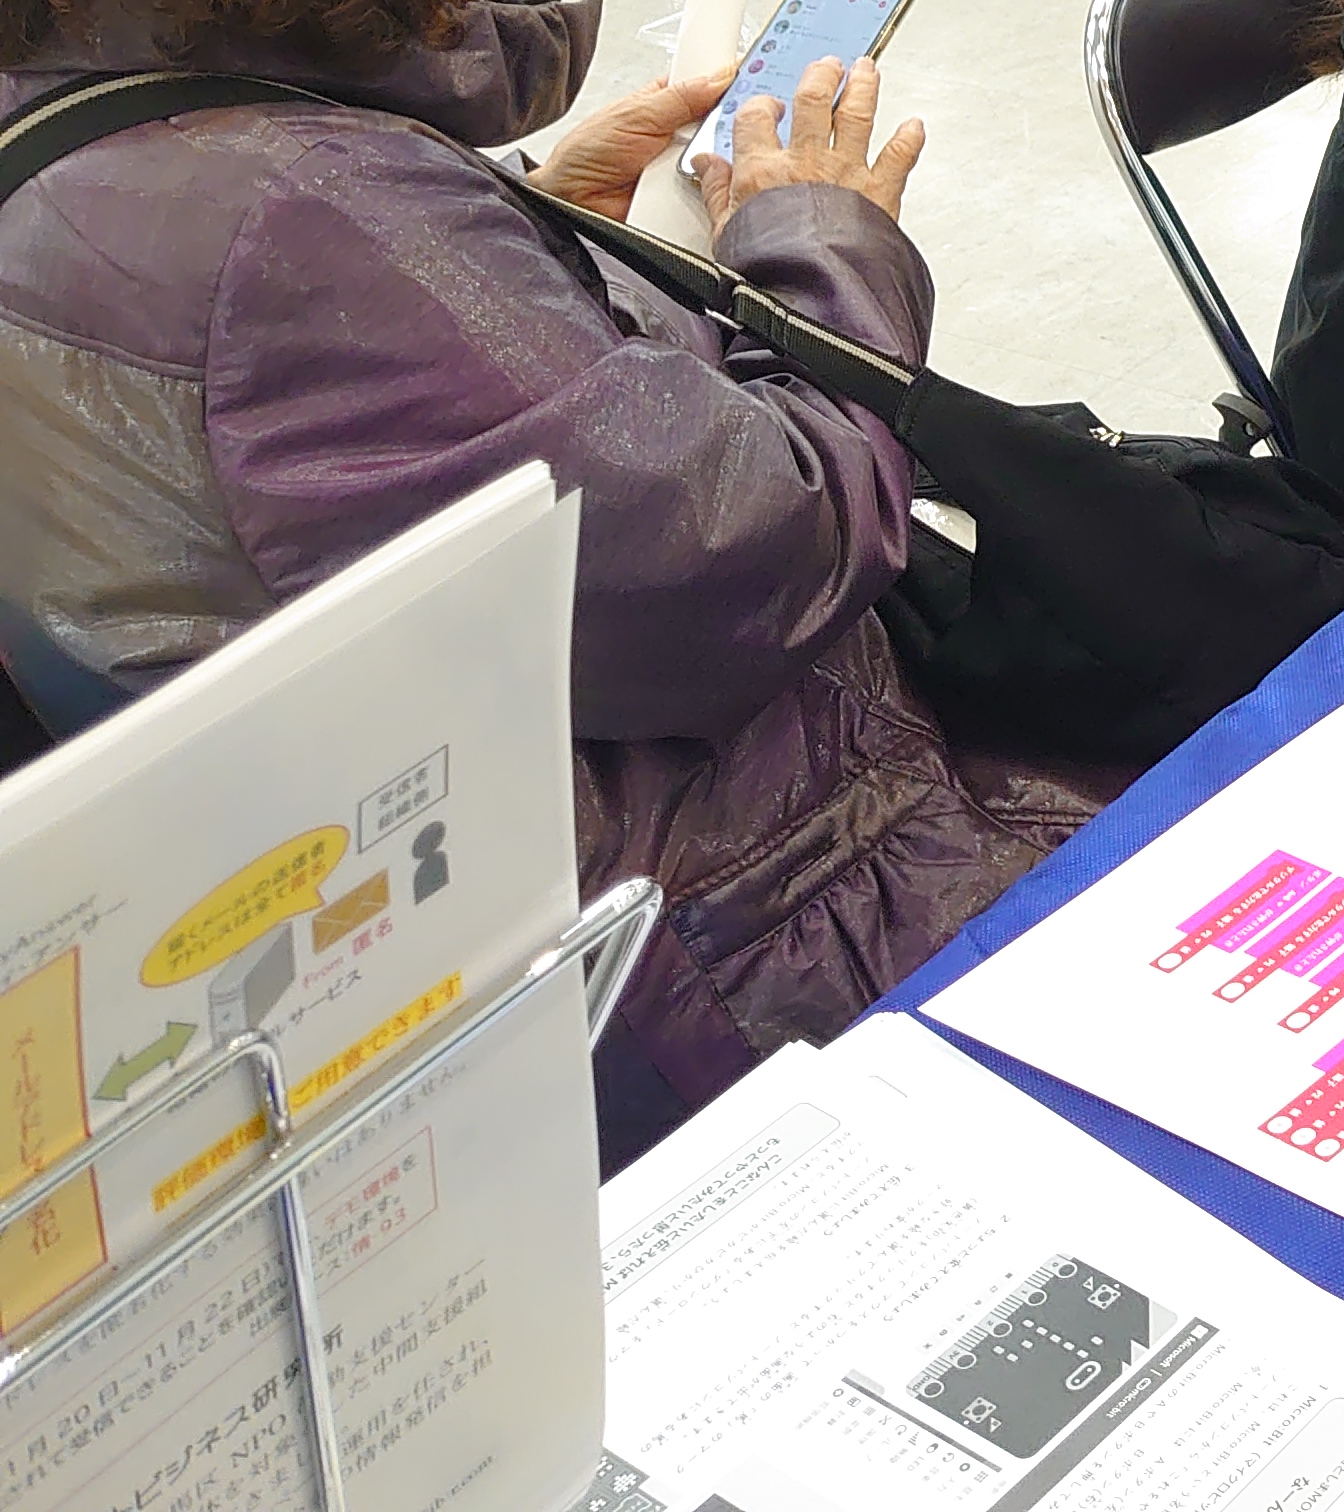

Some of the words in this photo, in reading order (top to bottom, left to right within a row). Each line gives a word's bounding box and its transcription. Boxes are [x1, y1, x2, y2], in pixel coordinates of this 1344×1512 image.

[1159, 1335, 1198, 1369] Microsoft
[1104, 1387, 1140, 1419] micro:bit
[1261, 1394, 1317, 1447] Micro:Bit
